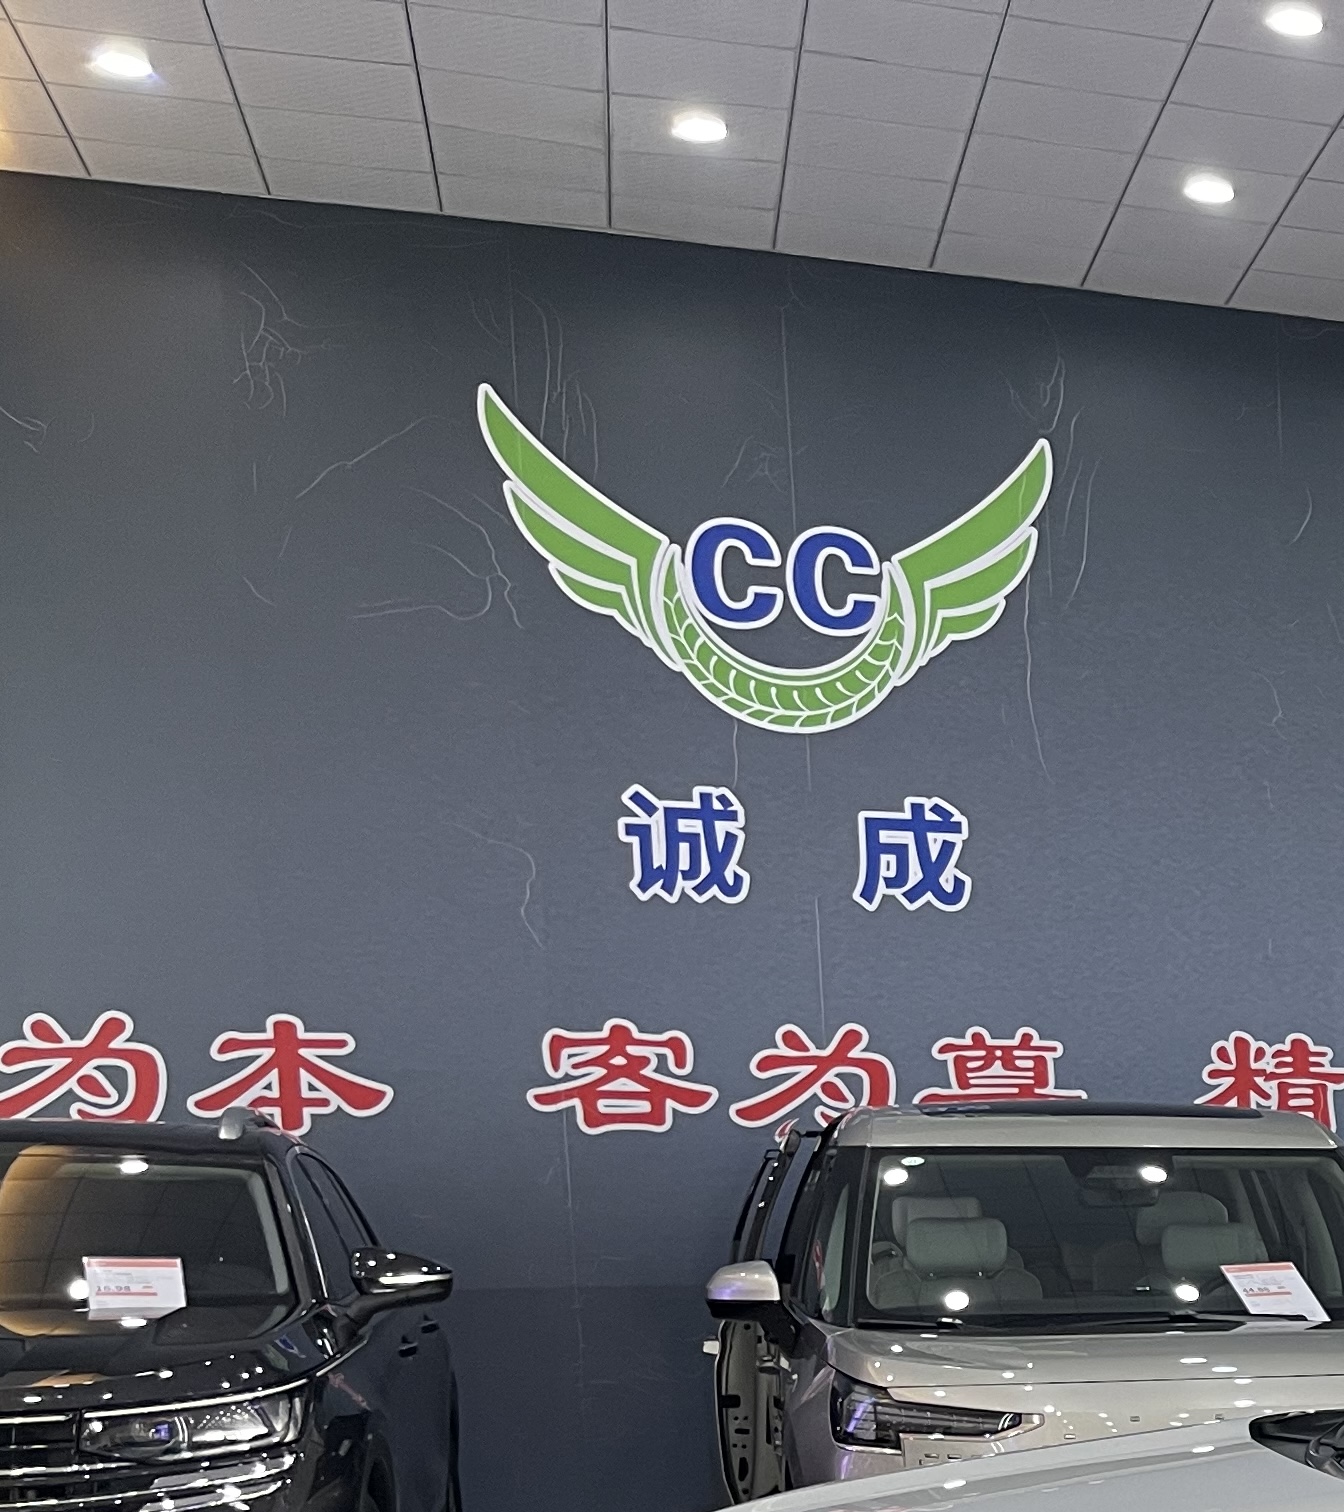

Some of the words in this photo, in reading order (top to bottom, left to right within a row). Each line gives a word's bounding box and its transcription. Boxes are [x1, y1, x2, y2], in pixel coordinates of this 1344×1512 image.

[685, 517, 882, 637] CC
[617, 783, 972, 912] 诚成
[0, 1010, 395, 1136] 为本
